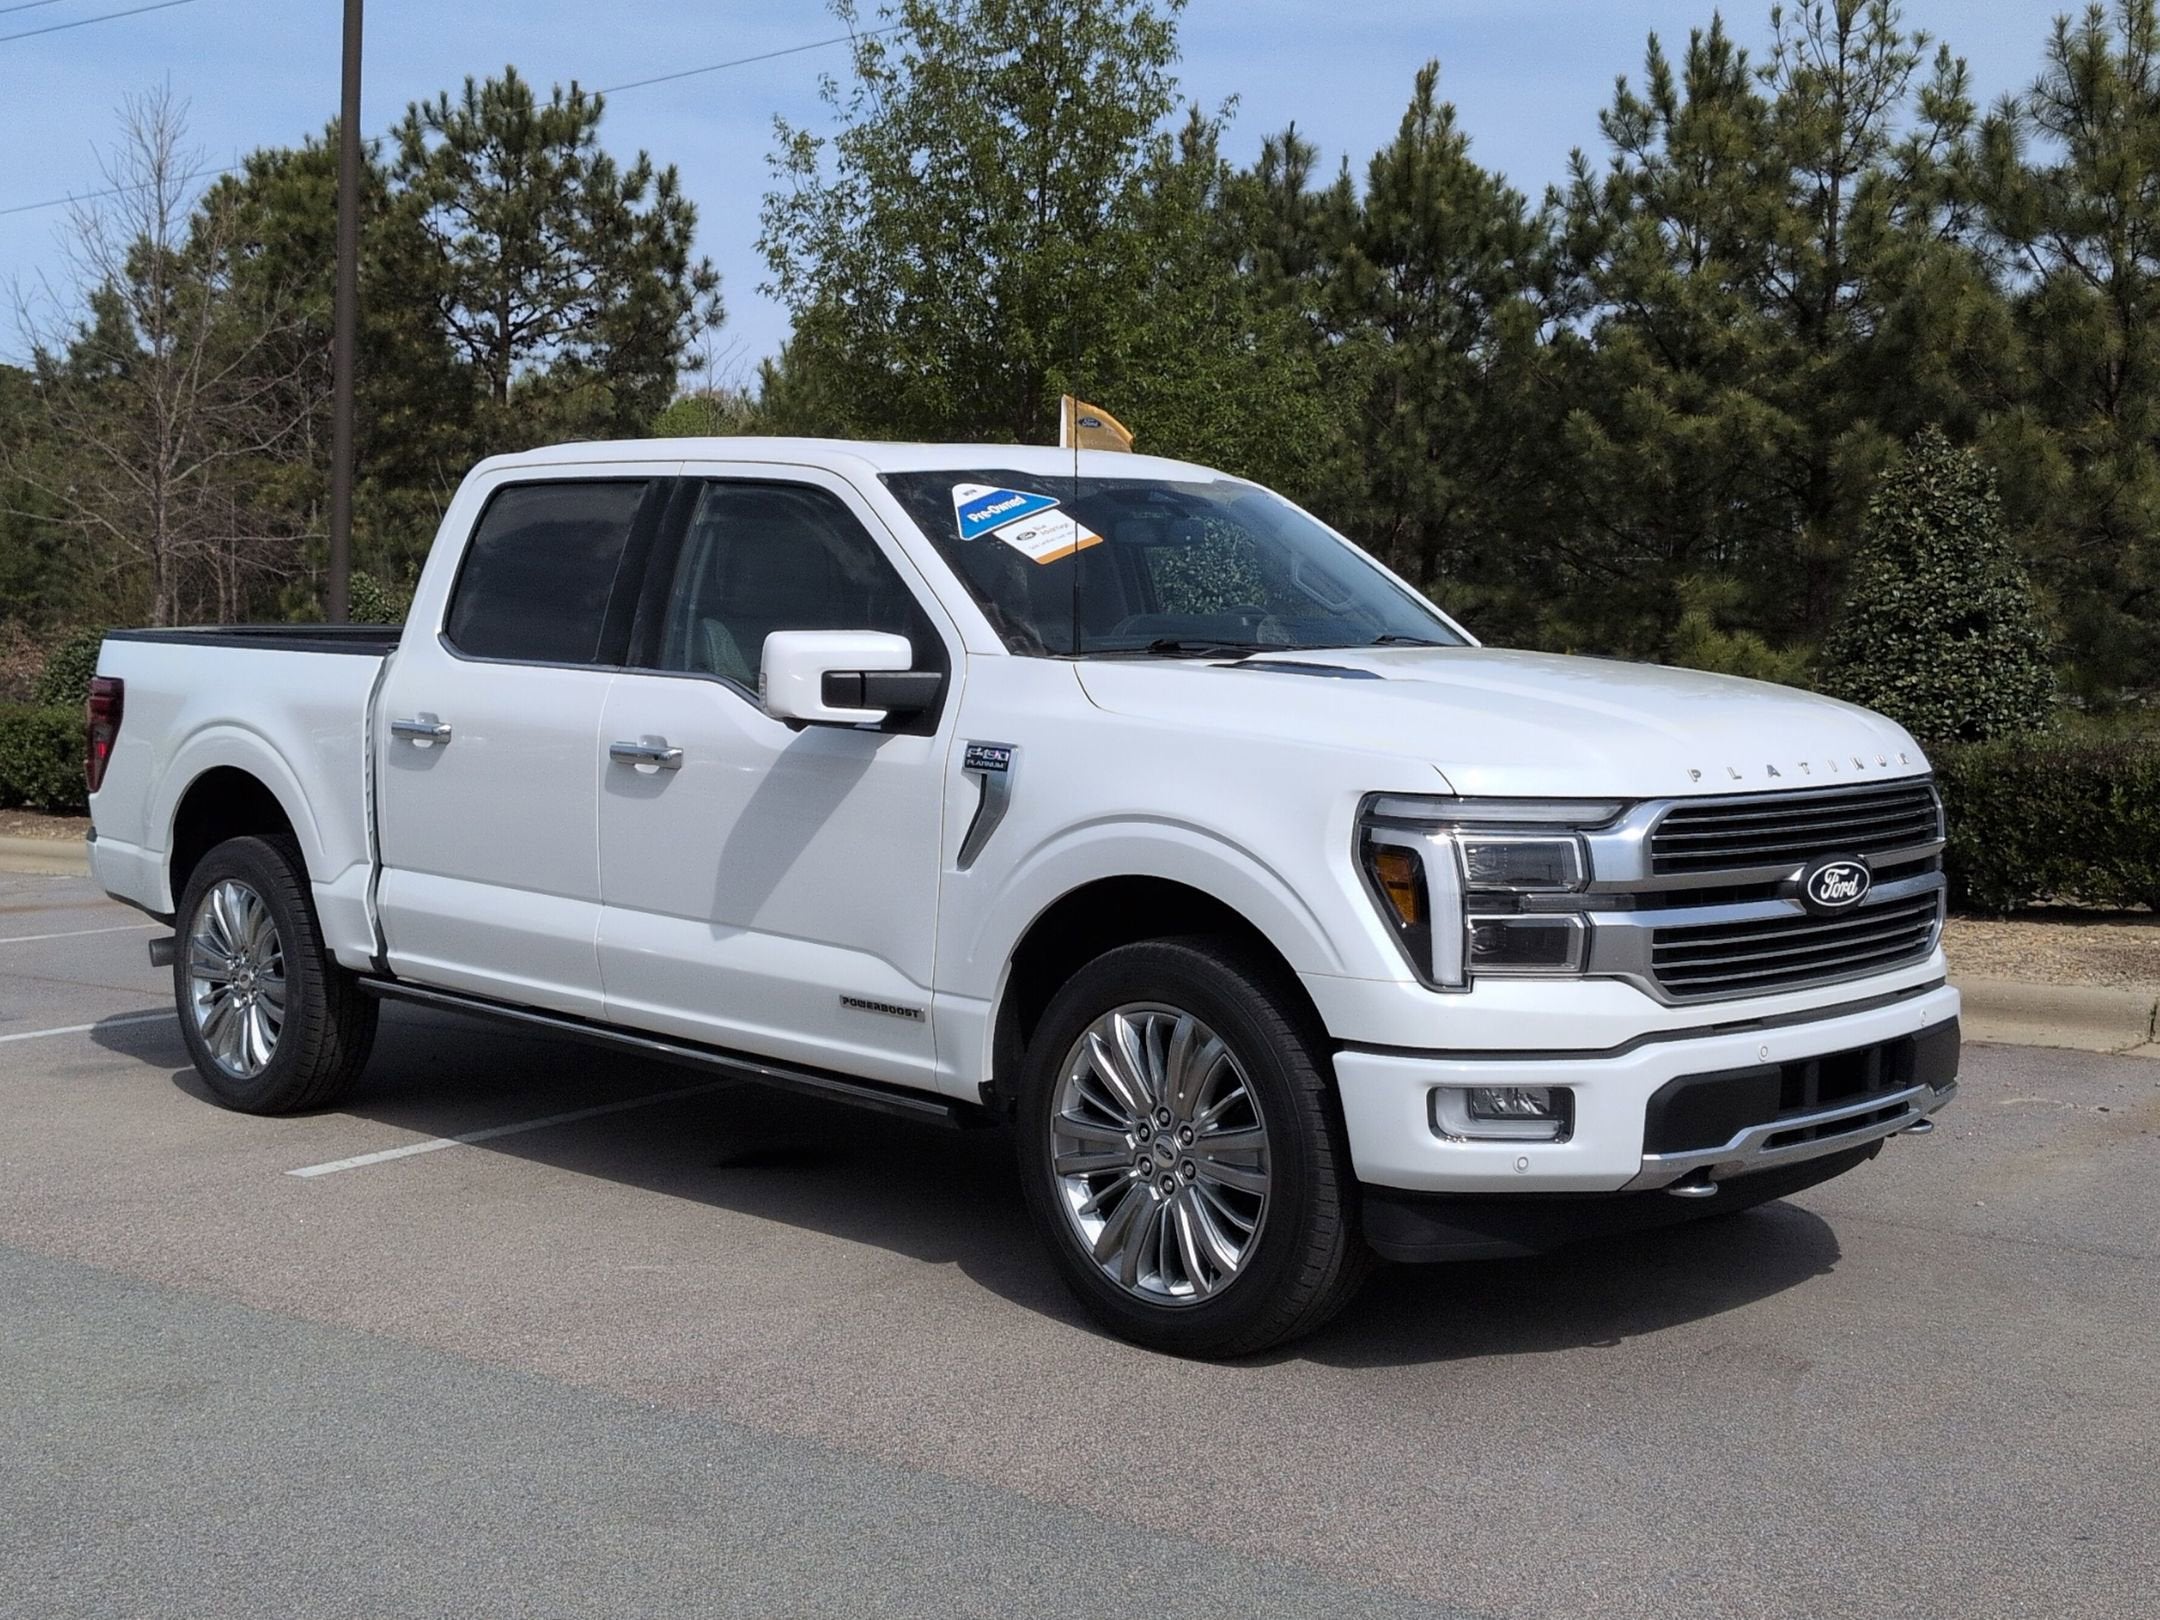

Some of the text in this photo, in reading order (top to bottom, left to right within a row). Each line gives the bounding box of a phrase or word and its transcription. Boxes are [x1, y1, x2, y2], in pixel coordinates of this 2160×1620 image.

[967, 495, 1027, 523] Pre-Owned
[966, 759, 1004, 769] PLATINUM
[1820, 868, 1859, 900] Ford
[842, 996, 919, 1018] POWERBOOST
